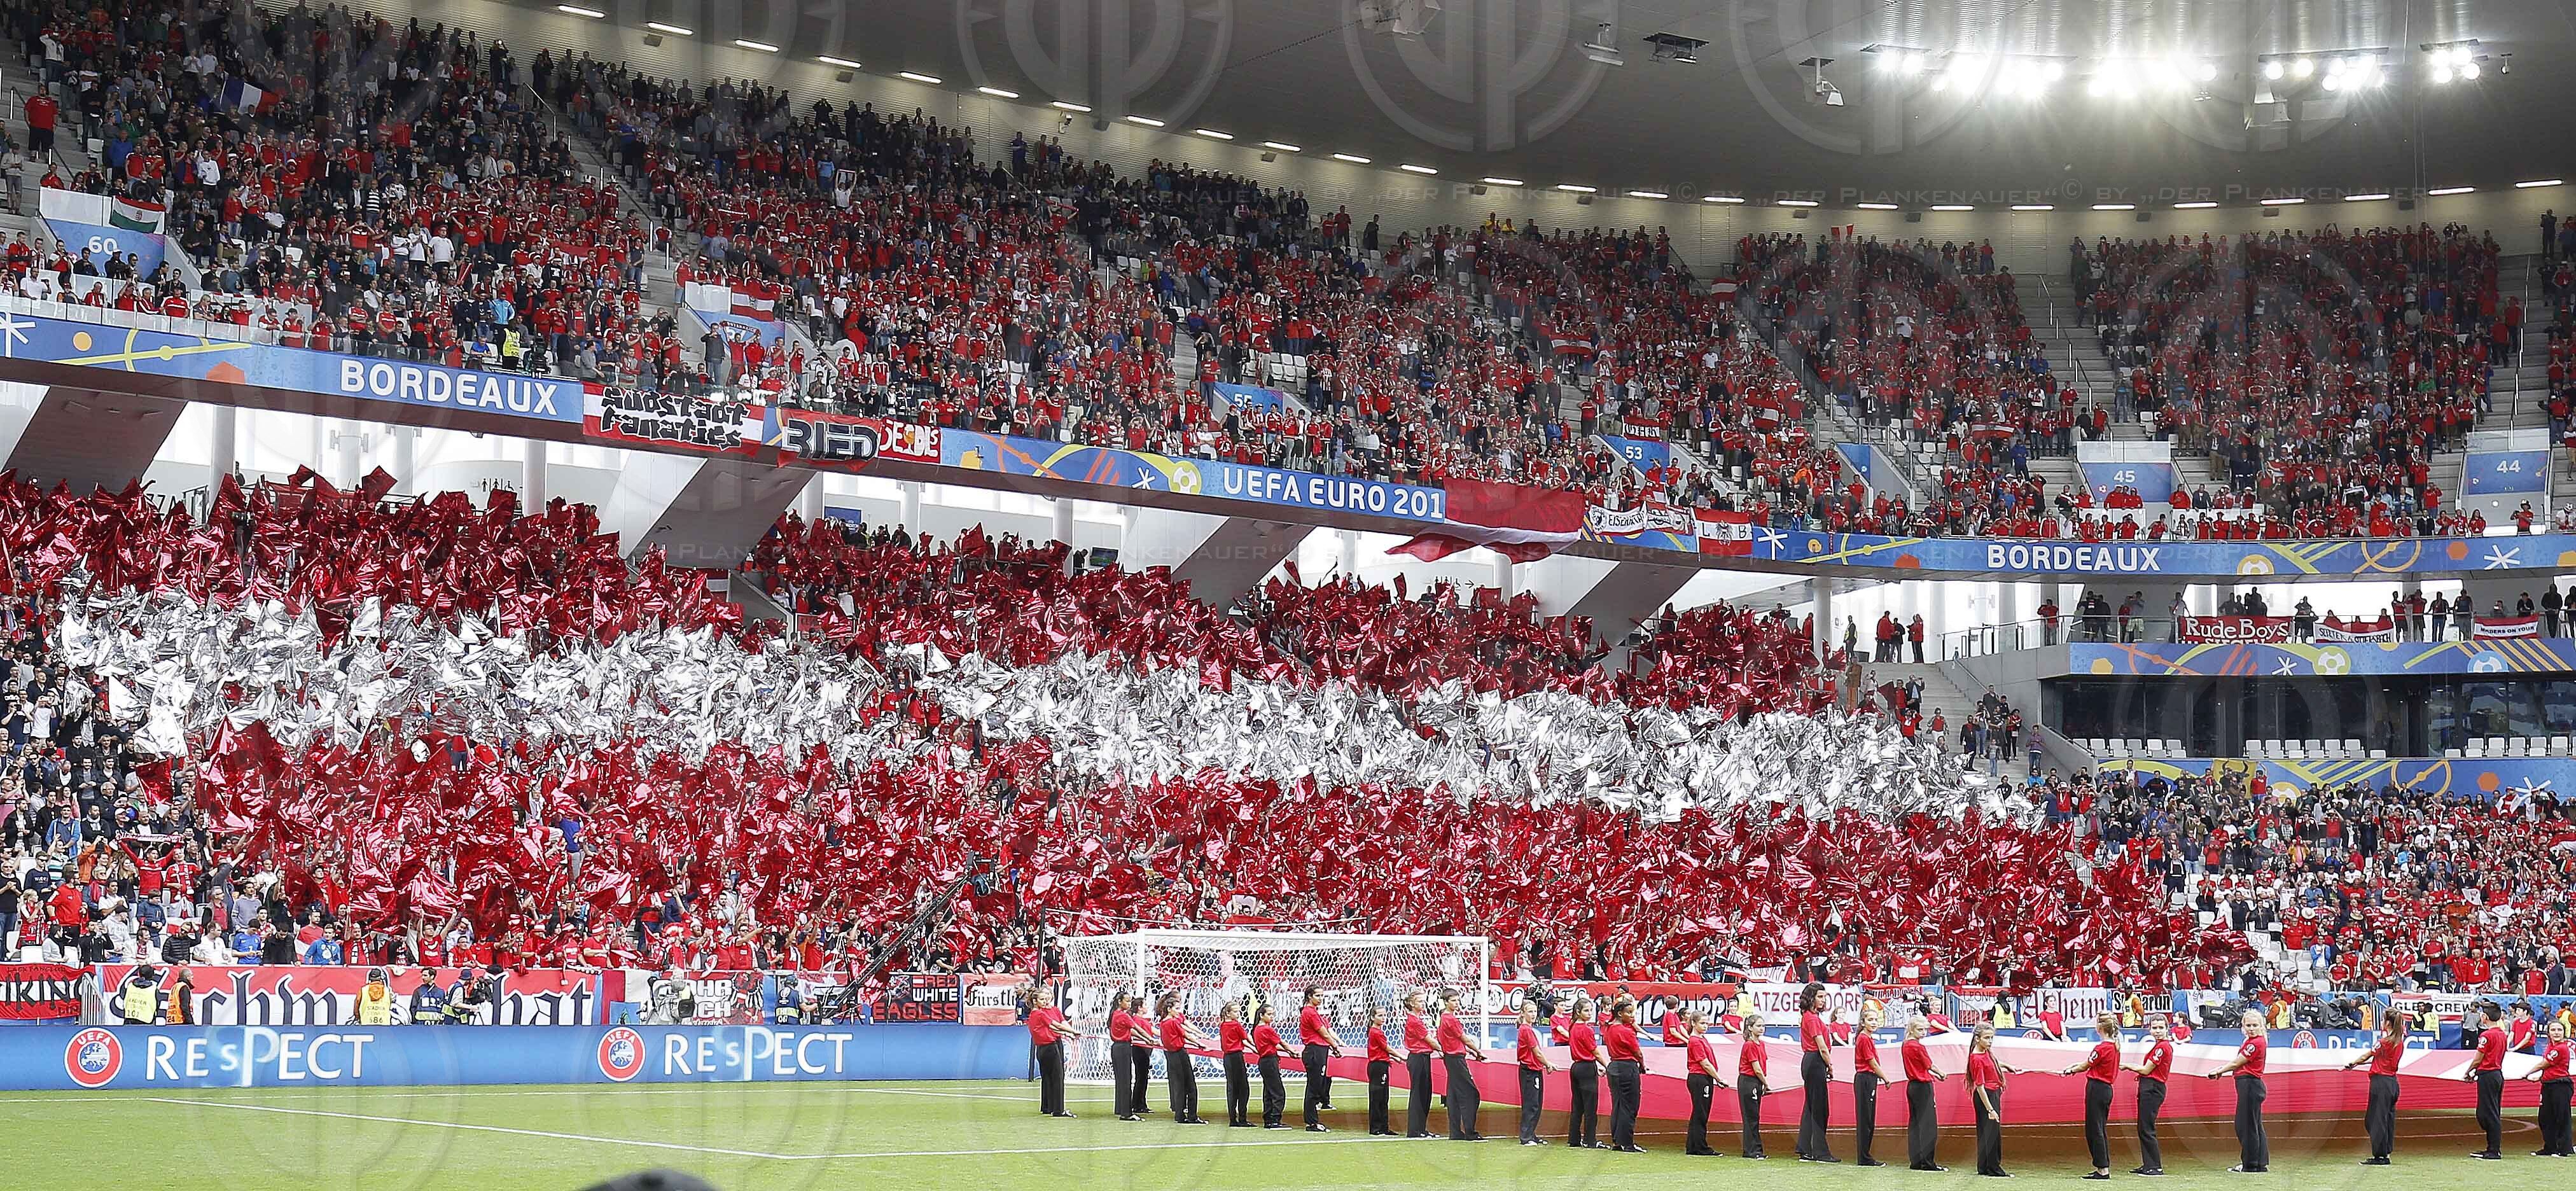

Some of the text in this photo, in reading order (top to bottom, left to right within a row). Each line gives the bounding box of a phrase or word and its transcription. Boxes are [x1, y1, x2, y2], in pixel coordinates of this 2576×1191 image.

[88, 236, 118, 256] 60
[340, 359, 558, 415] BORDEAUX
[1626, 446, 1643, 460] 53
[2496, 459, 2521, 473] 44
[2113, 470, 2137, 484] 45
[1223, 467, 1302, 503] UEFA
[1309, 478, 1386, 512] EURO
[1986, 544, 2162, 571] BORDEAUX
[2185, 617, 2289, 640] Rude Boys
[912, 987, 958, 1001] WHITE
[874, 1003, 958, 1020] EAGLES
[76, 1031, 111, 1047] UEFA
[608, 1030, 637, 1043] UEFA
